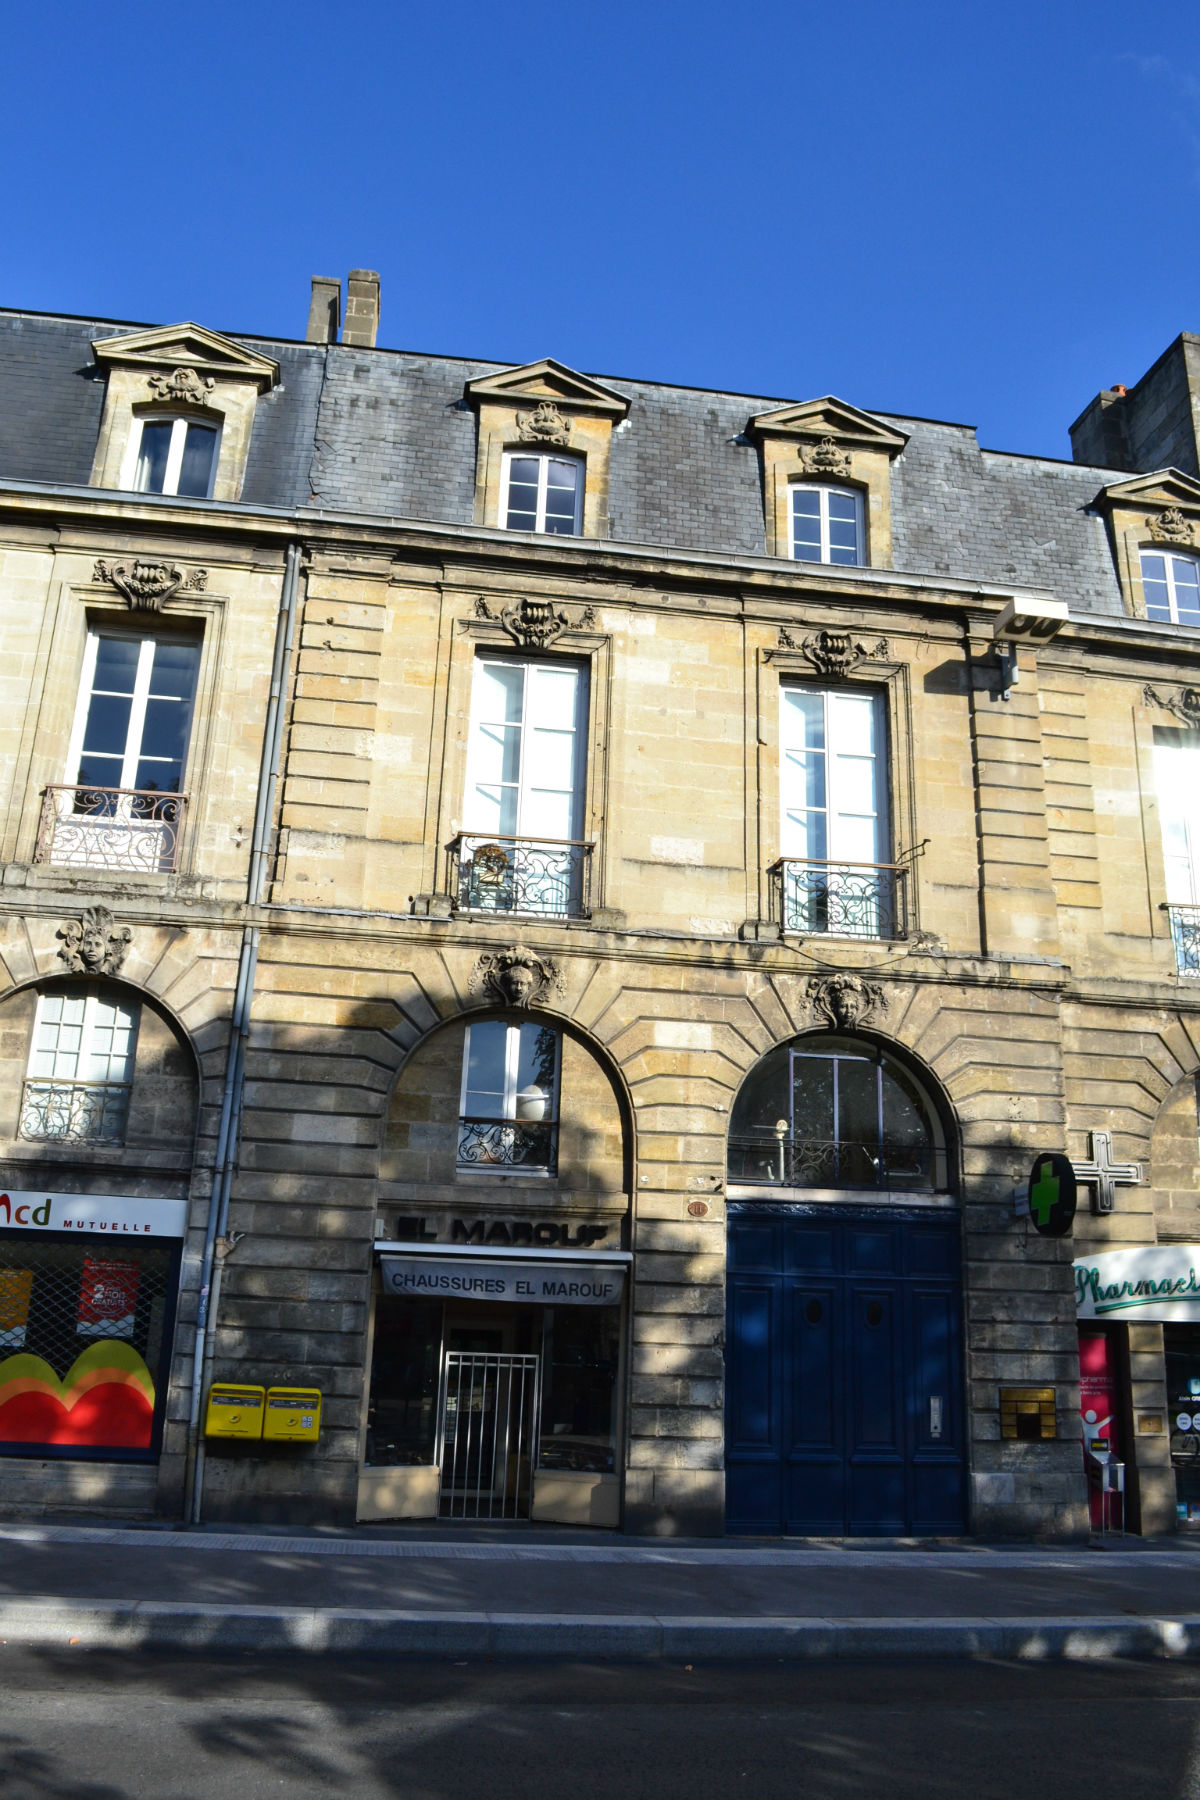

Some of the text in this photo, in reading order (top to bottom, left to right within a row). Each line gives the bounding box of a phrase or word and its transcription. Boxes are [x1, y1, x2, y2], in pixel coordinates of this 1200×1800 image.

[63, 1220, 152, 1232] MUTUELLE
[398, 1216, 609, 1247] EL MAROUF
[93, 1284, 105, 1299] 2
[392, 1273, 613, 1298] CHAUSSURES EL MAROUF
[1074, 1265, 1200, 1307] Pharmaci
